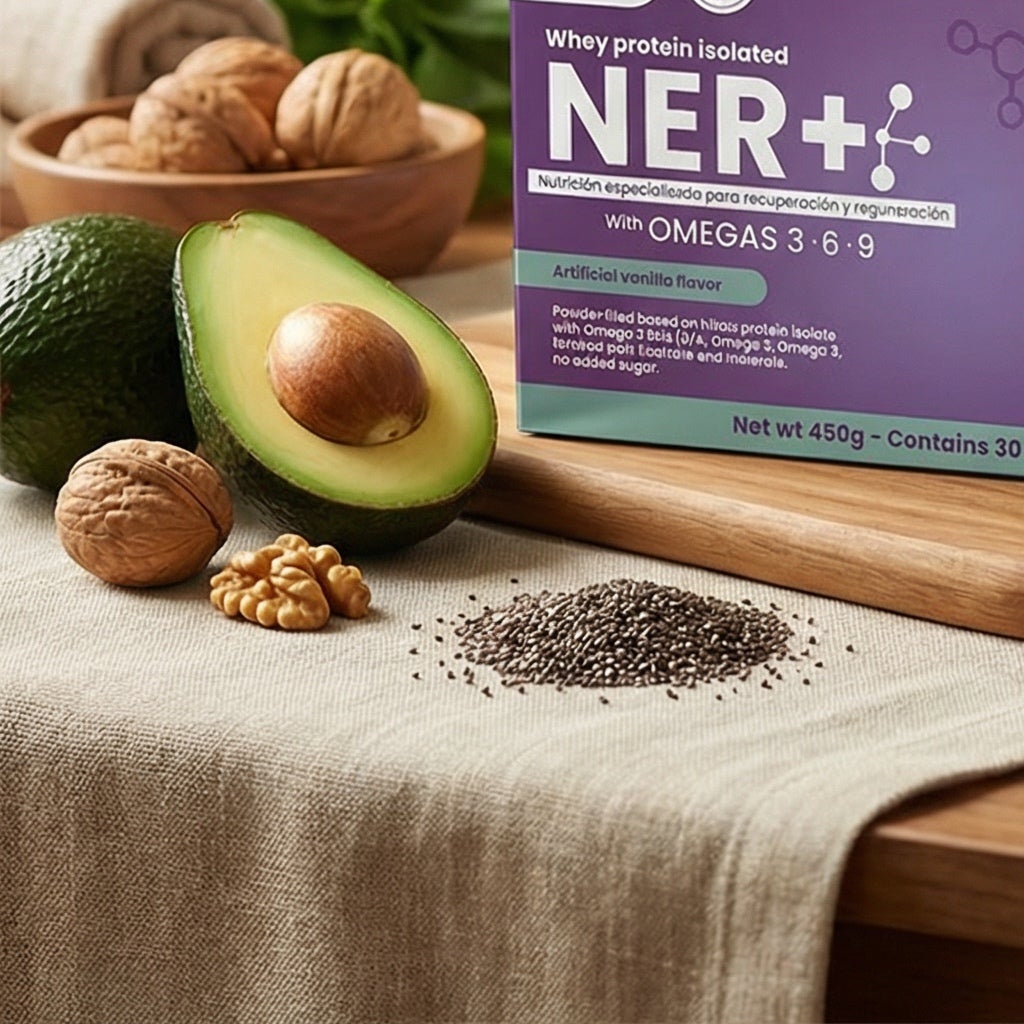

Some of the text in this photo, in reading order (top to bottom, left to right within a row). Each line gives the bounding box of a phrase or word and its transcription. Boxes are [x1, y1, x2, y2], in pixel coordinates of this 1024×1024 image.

[545, 28, 789, 67] Whey protein isolated
[842, 202, 850, 216] y
[605, 214, 644, 232] With
[648, 216, 778, 252] OMEGAS
[676, 273, 723, 293] flavor
[680, 318, 699, 330] on
[552, 354, 571, 366] no
[732, 415, 771, 437] Net
[776, 420, 803, 439] wt
[808, 422, 865, 451] 450g
[887, 429, 989, 457] Contains
[994, 437, 1022, 458] 30
